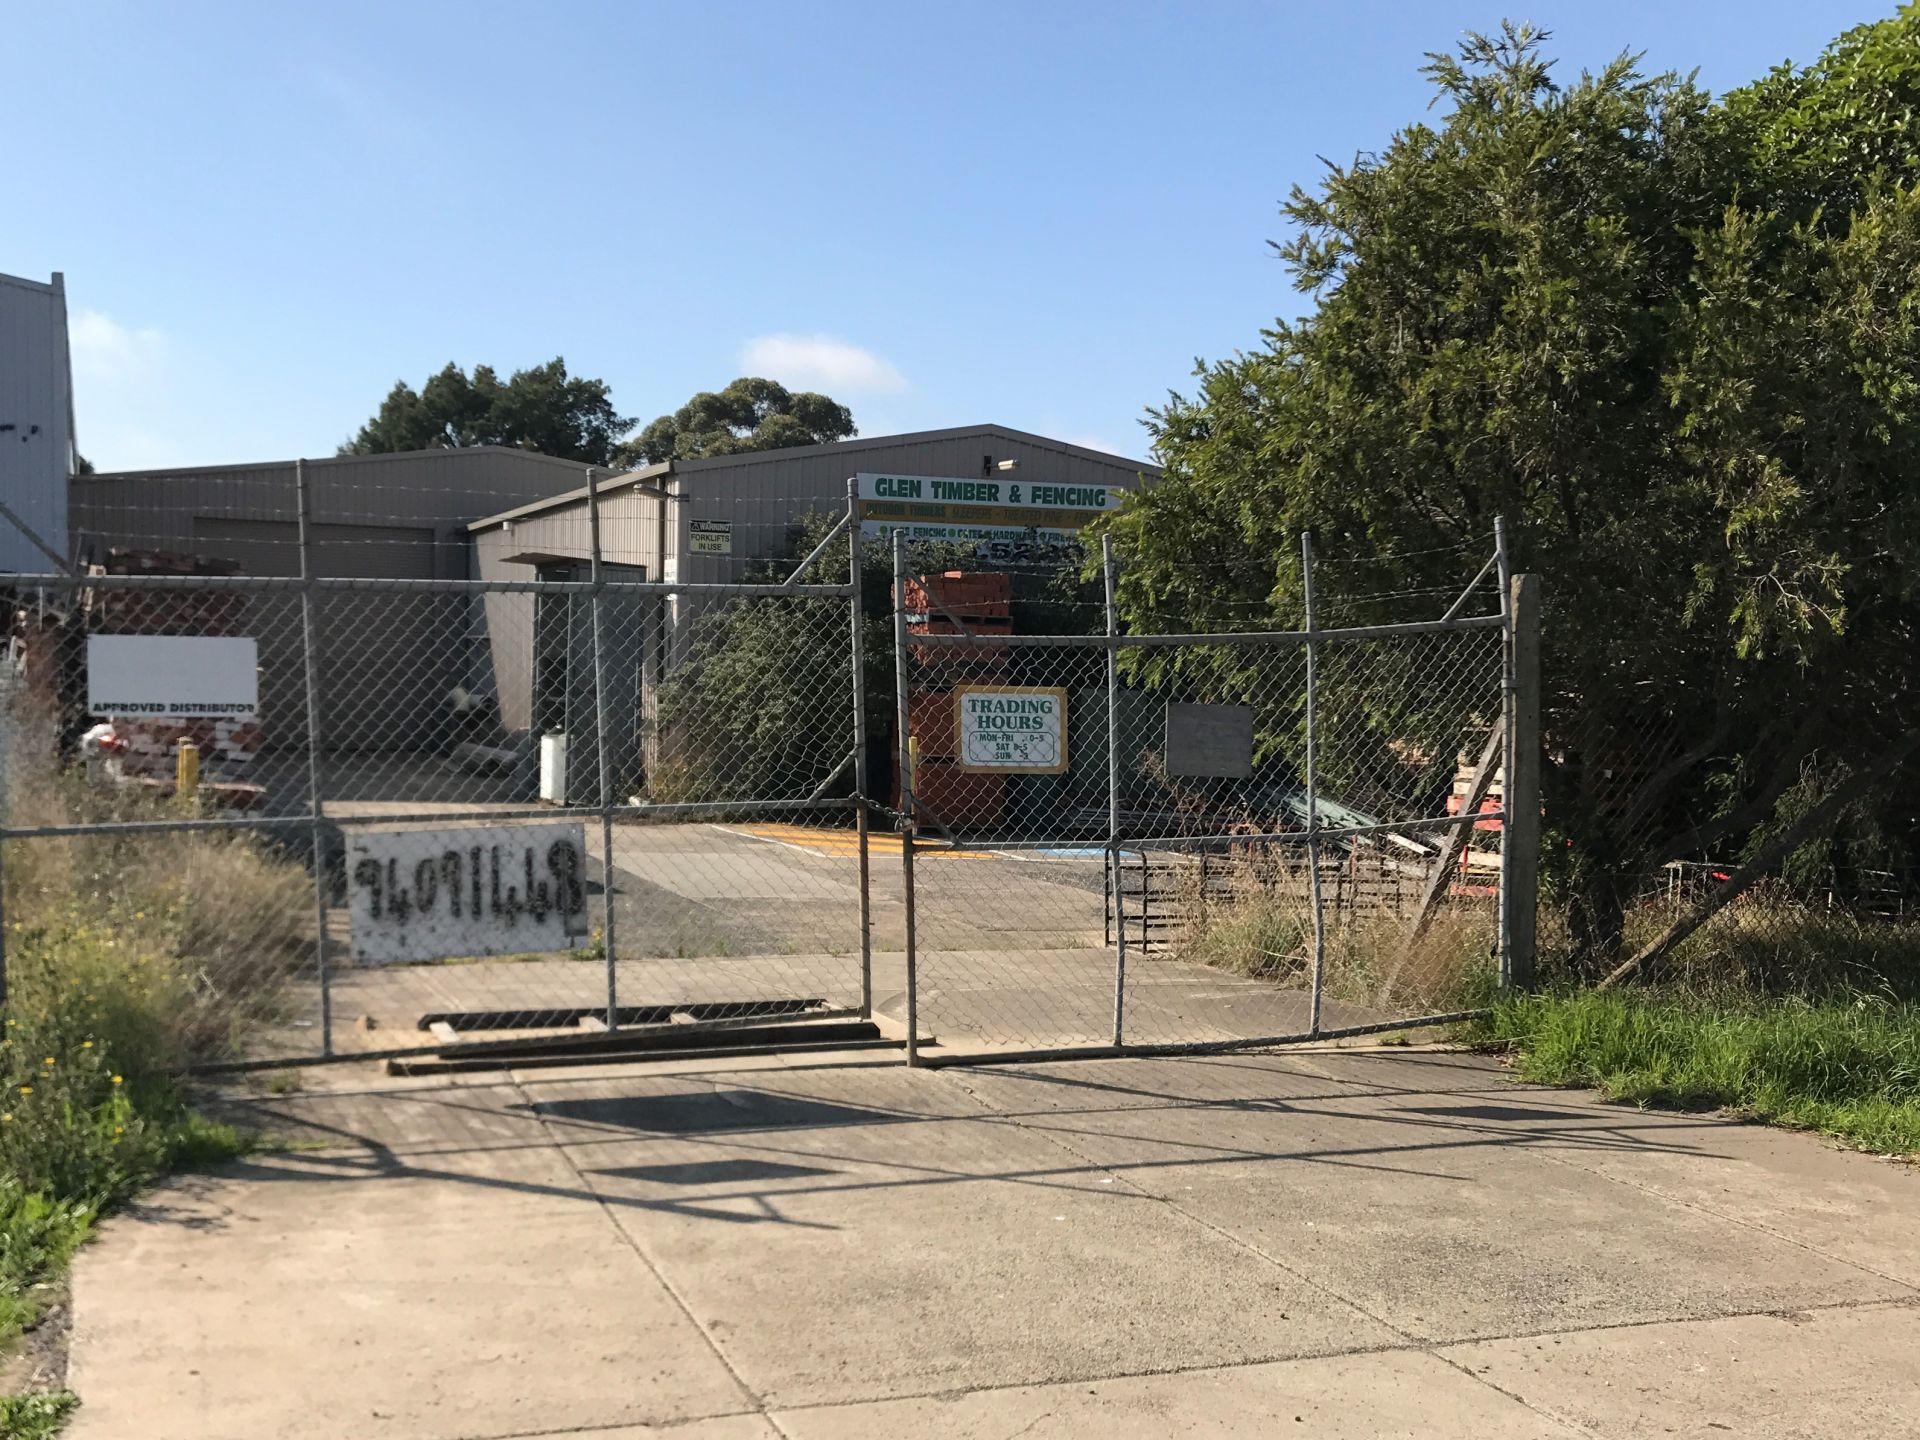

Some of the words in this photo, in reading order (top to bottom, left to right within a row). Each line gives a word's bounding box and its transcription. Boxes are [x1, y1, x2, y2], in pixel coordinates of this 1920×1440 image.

[875, 478, 922, 498] GLEN
[931, 481, 1000, 502] TIMBER
[1008, 484, 1021, 503] &
[1031, 486, 1106, 507] FENCING
[700, 523, 730, 532] WARNING
[913, 527, 947, 538] FENCING
[691, 534, 730, 543] FORKLIFTS
[707, 543, 722, 551] USE
[93, 703, 166, 713] APPROVED
[169, 703, 255, 713] DISTRIBUTOR
[968, 699, 1053, 714] TRADING
[977, 715, 1044, 730] HOURS
[980, 733, 1014, 742] MON-FRI
[996, 743, 1010, 751] SAT
[995, 752, 1011, 760] SUN
